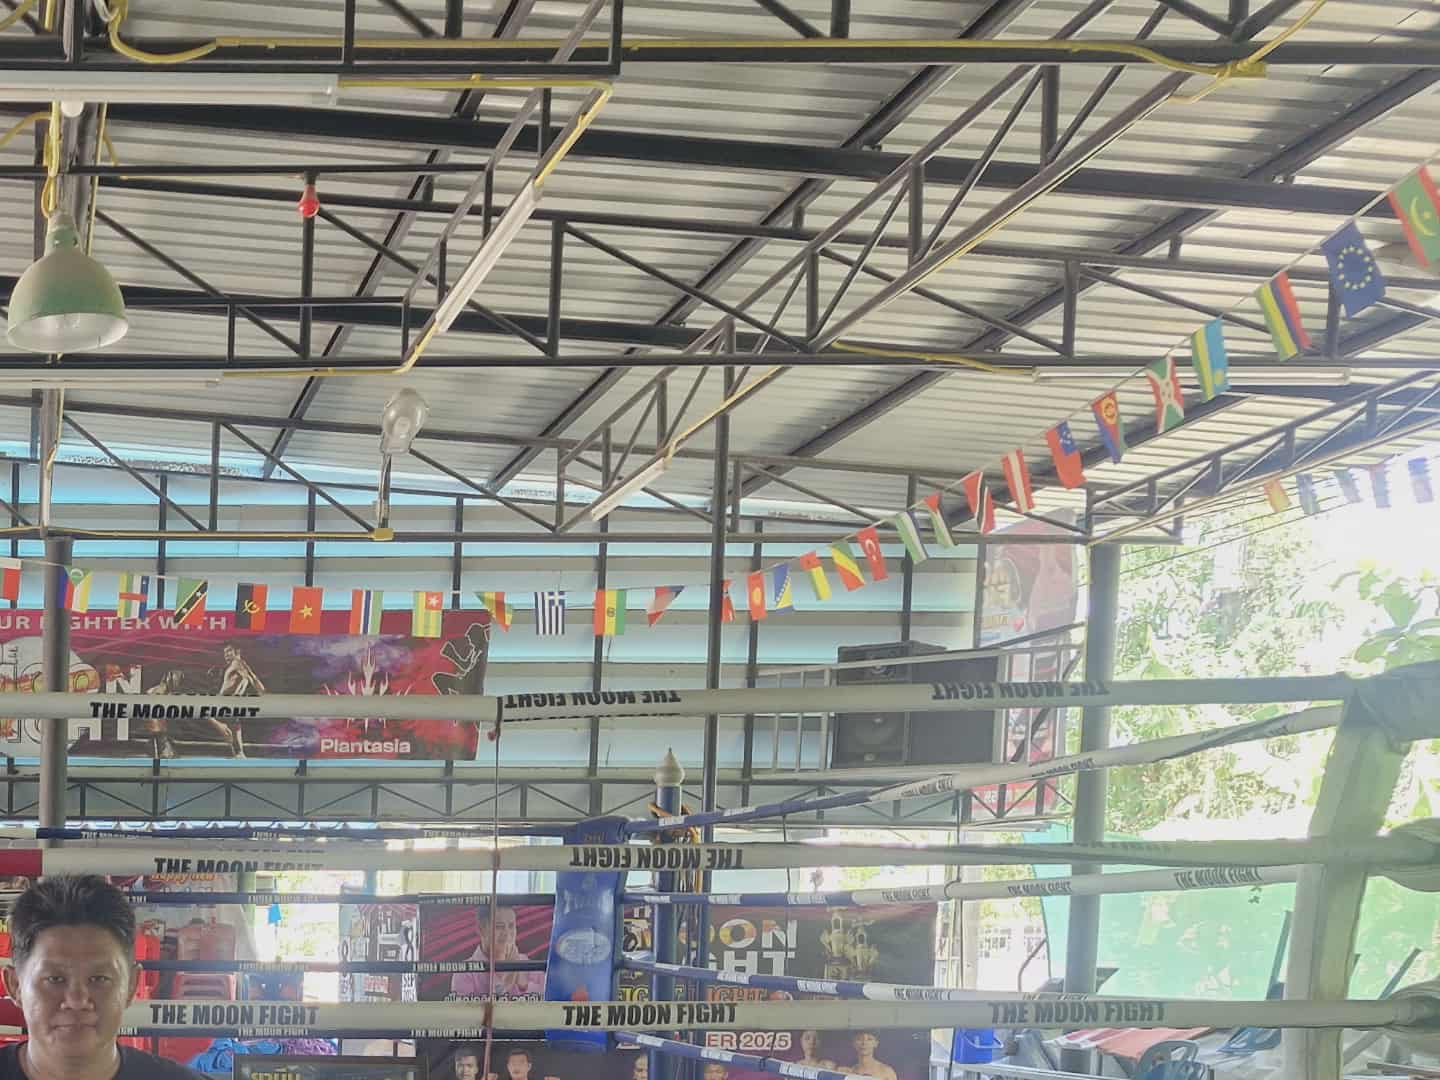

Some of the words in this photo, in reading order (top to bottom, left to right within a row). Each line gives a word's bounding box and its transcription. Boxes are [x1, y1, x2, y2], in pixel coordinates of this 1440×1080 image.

[40, 615, 150, 630] GHTER
[90, 702, 127, 719] THE
[132, 703, 195, 719] MOON
[320, 738, 410, 753] Plantasia
[154, 857, 191, 872] THE
[197, 859, 258, 872] MOON
[569, 847, 631, 868] FIGHT
[637, 847, 700, 869] MOON
[705, 848, 744, 869] THE
[150, 1004, 187, 1024] THE
[192, 1005, 253, 1025] MOON
[259, 1005, 319, 1025] FIGHT
[562, 1005, 602, 1025] THE
[608, 1004, 670, 1025] MOON
[677, 1003, 738, 1024] FIGHT
[990, 1001, 1028, 1023] THE
[1034, 1001, 1099, 1022] MOON
[1104, 1001, 1167, 1021] FIGHT
[740, 1032, 791, 1050] 2025
